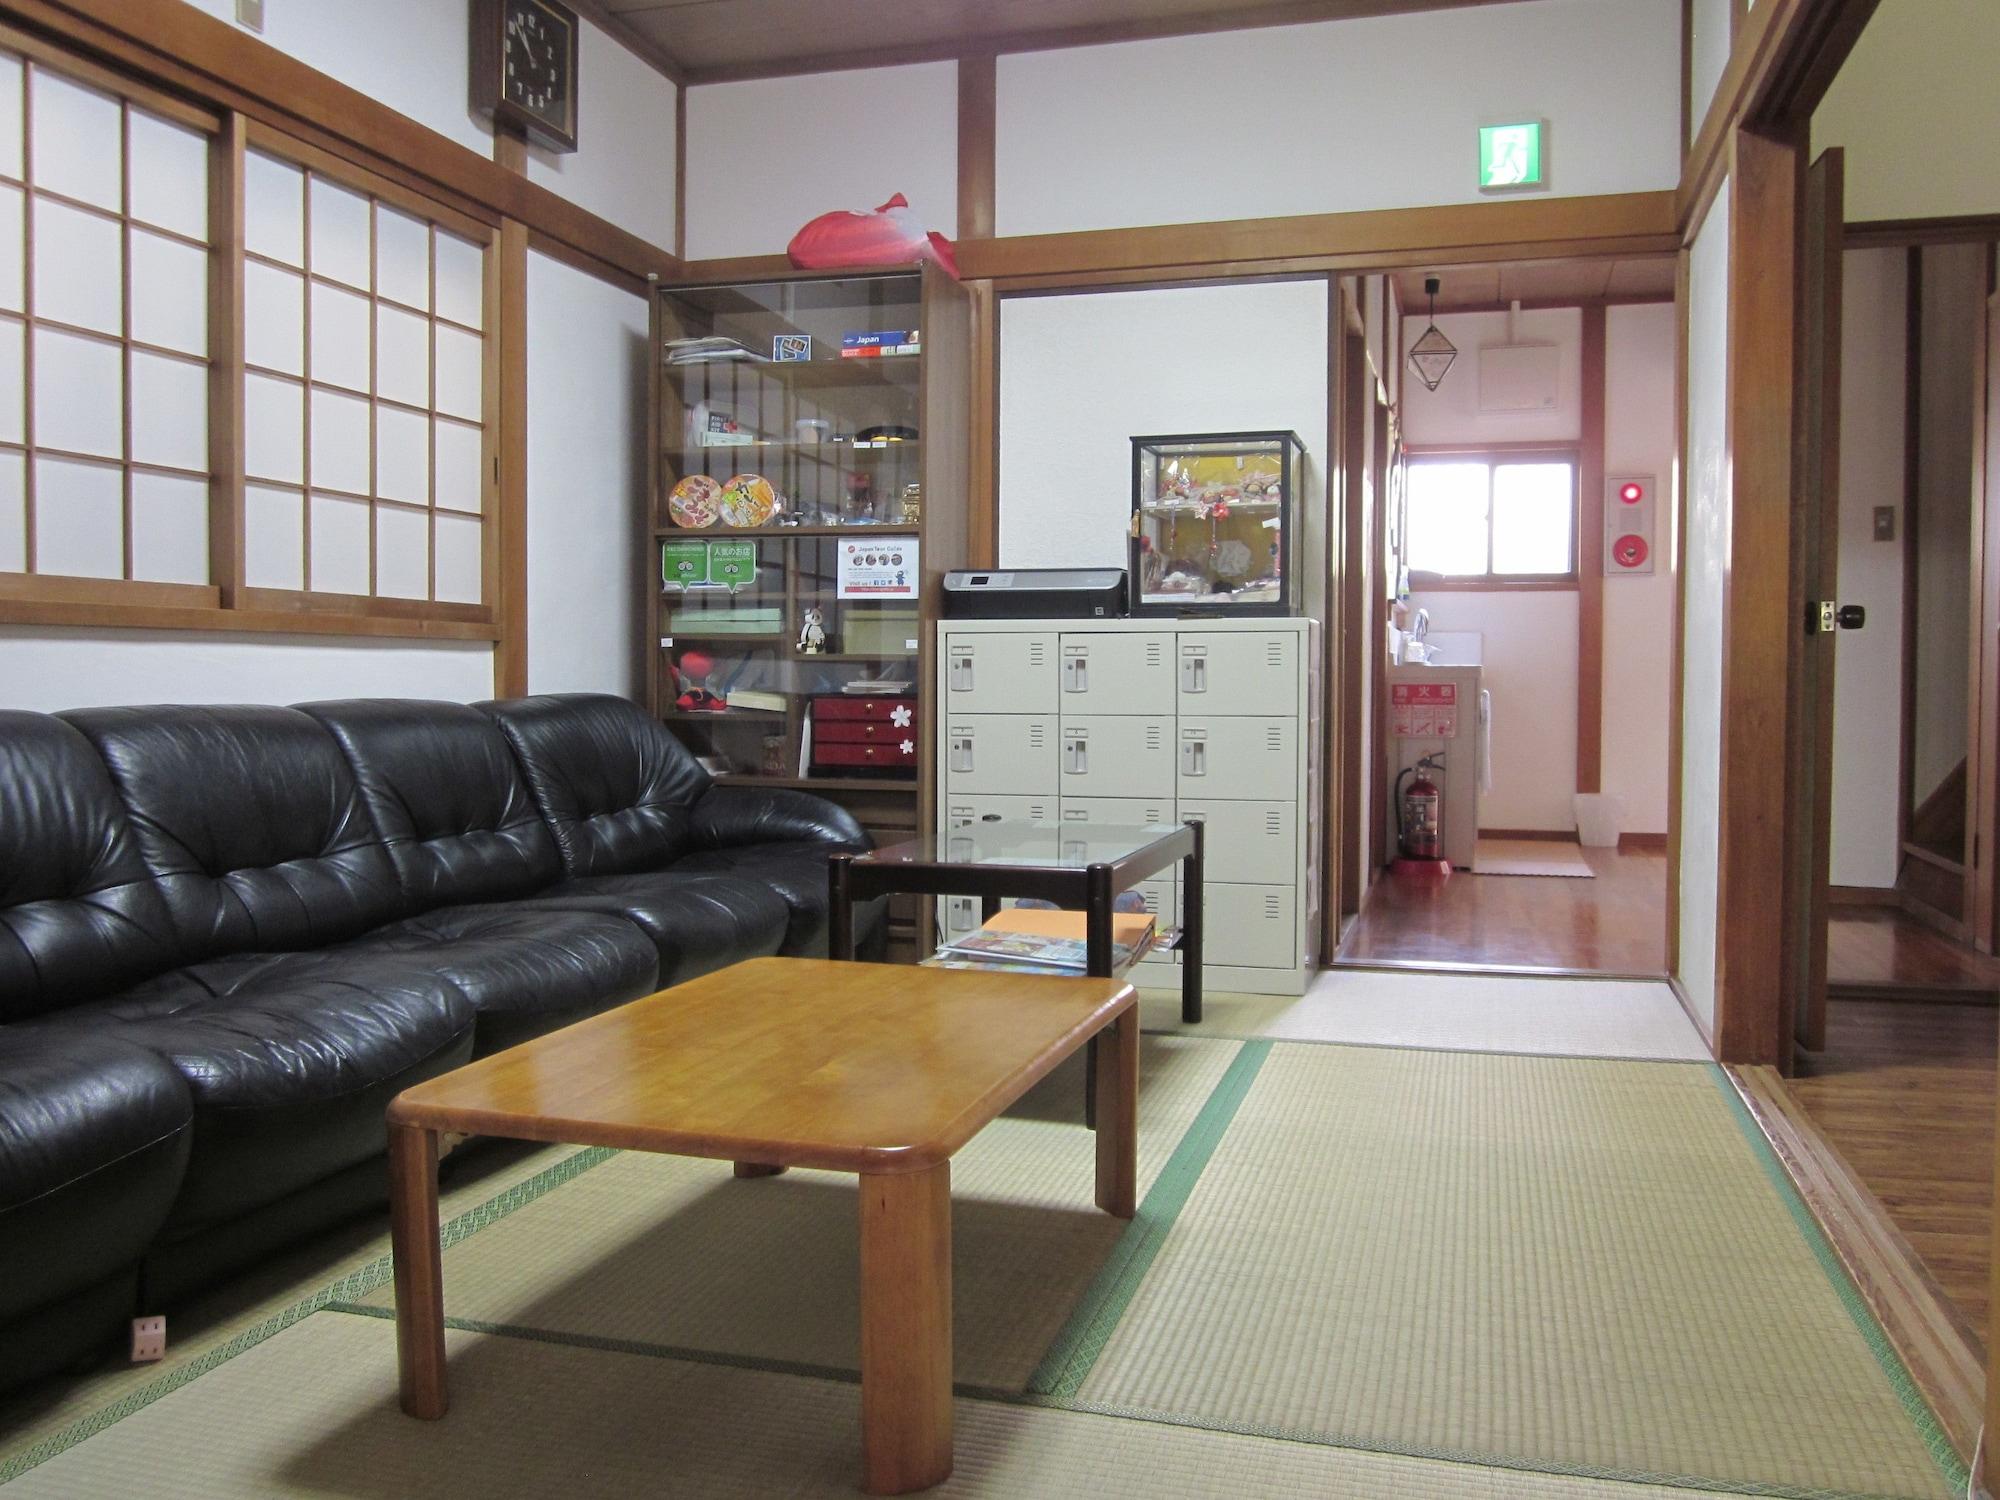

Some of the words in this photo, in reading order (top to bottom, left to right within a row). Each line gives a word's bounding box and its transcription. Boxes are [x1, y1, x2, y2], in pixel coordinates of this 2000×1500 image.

[528, 14, 535, 29] 12
[540, 27, 544, 40] 1
[517, 82, 523, 95] 7
[857, 336, 880, 345] Japan
